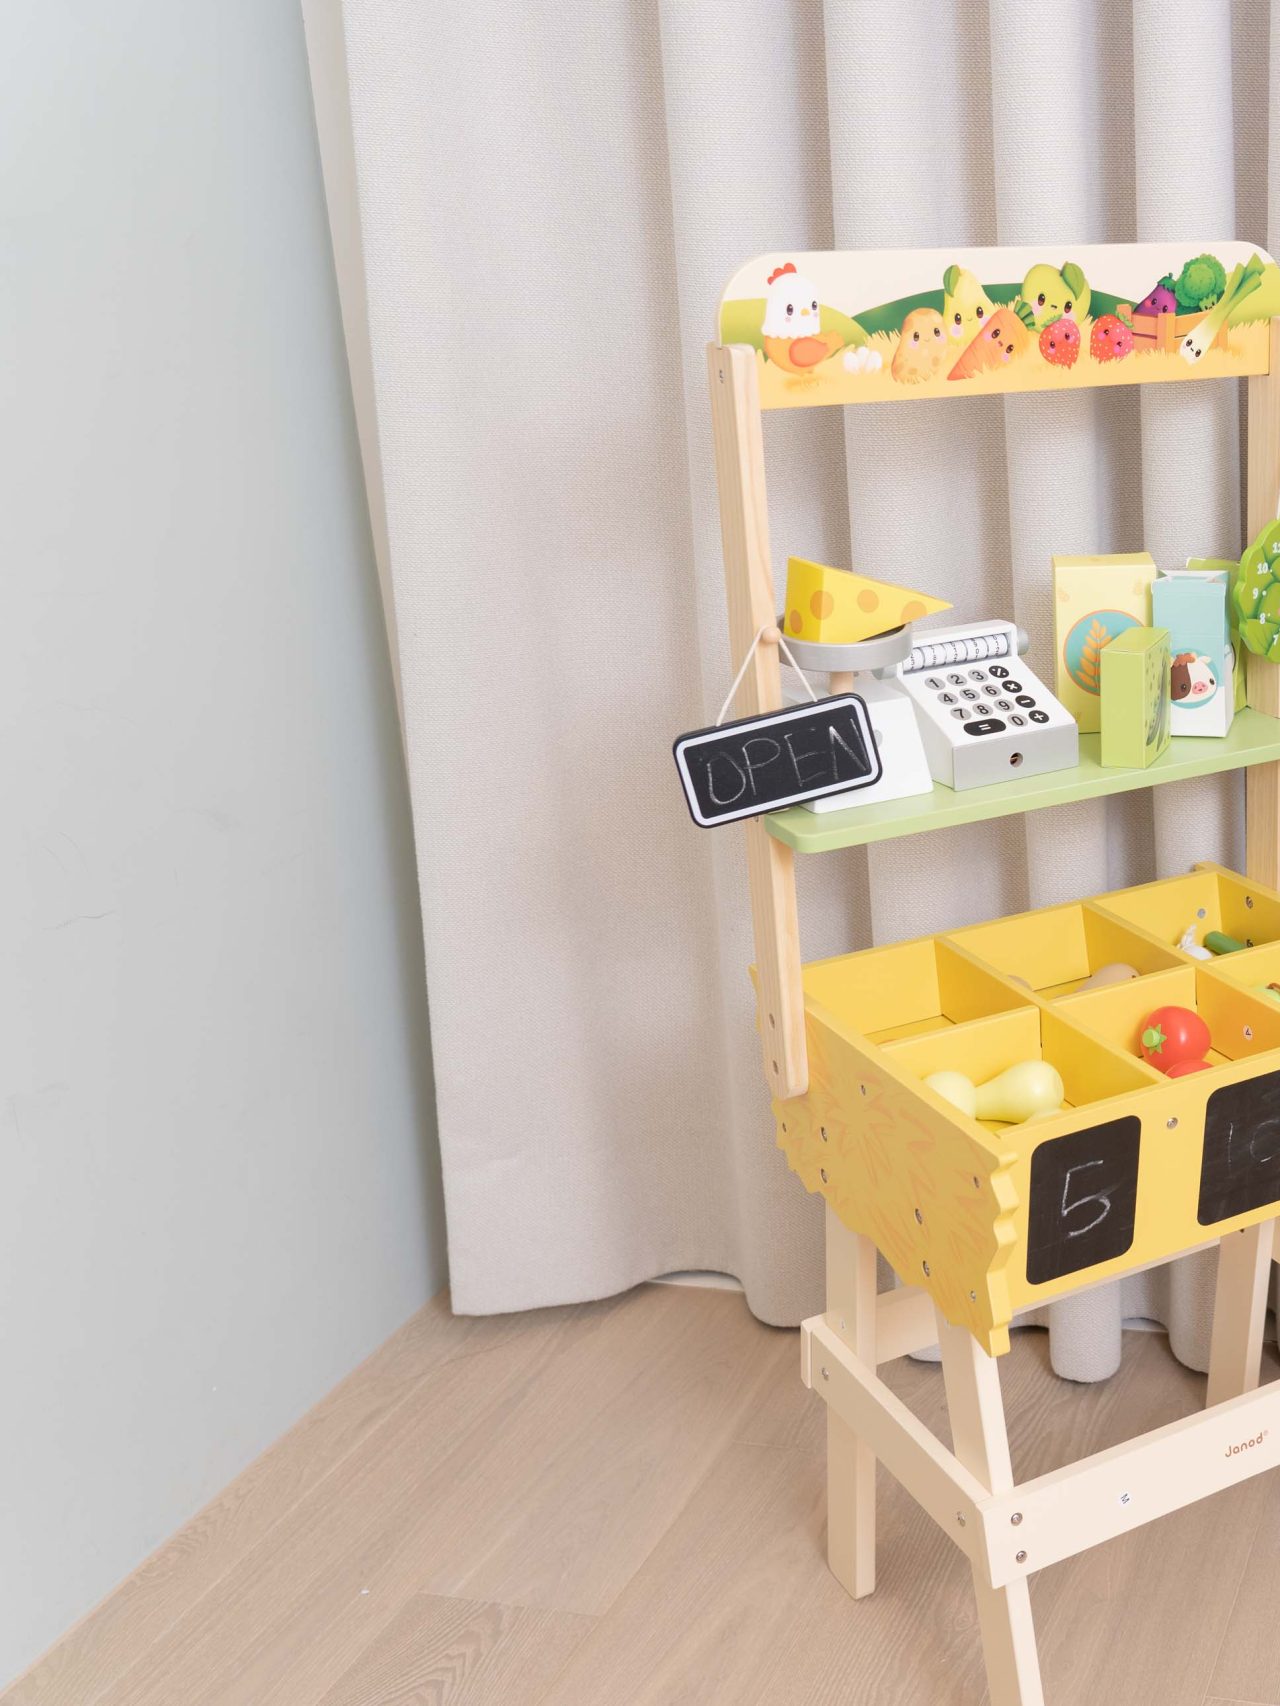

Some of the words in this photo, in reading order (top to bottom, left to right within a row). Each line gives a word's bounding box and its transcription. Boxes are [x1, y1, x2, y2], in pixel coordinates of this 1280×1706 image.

[1257, 562, 1269, 574] 10
[1252, 588, 1258, 599] 9
[1260, 613, 1266, 624] 8
[1273, 635, 1279, 645] 7
[951, 674, 963, 685] 2
[972, 670, 985, 681] 3
[943, 693, 954, 703] 4
[963, 690, 976, 700] 5
[985, 686, 997, 696] 6
[954, 708, 966, 719] 7
[977, 704, 989, 715] 8
[998, 700, 1010, 711] 9
[1012, 715, 1024, 726] 0
[706, 718, 870, 805] OPEN
[1061, 1159, 1111, 1238] 5
